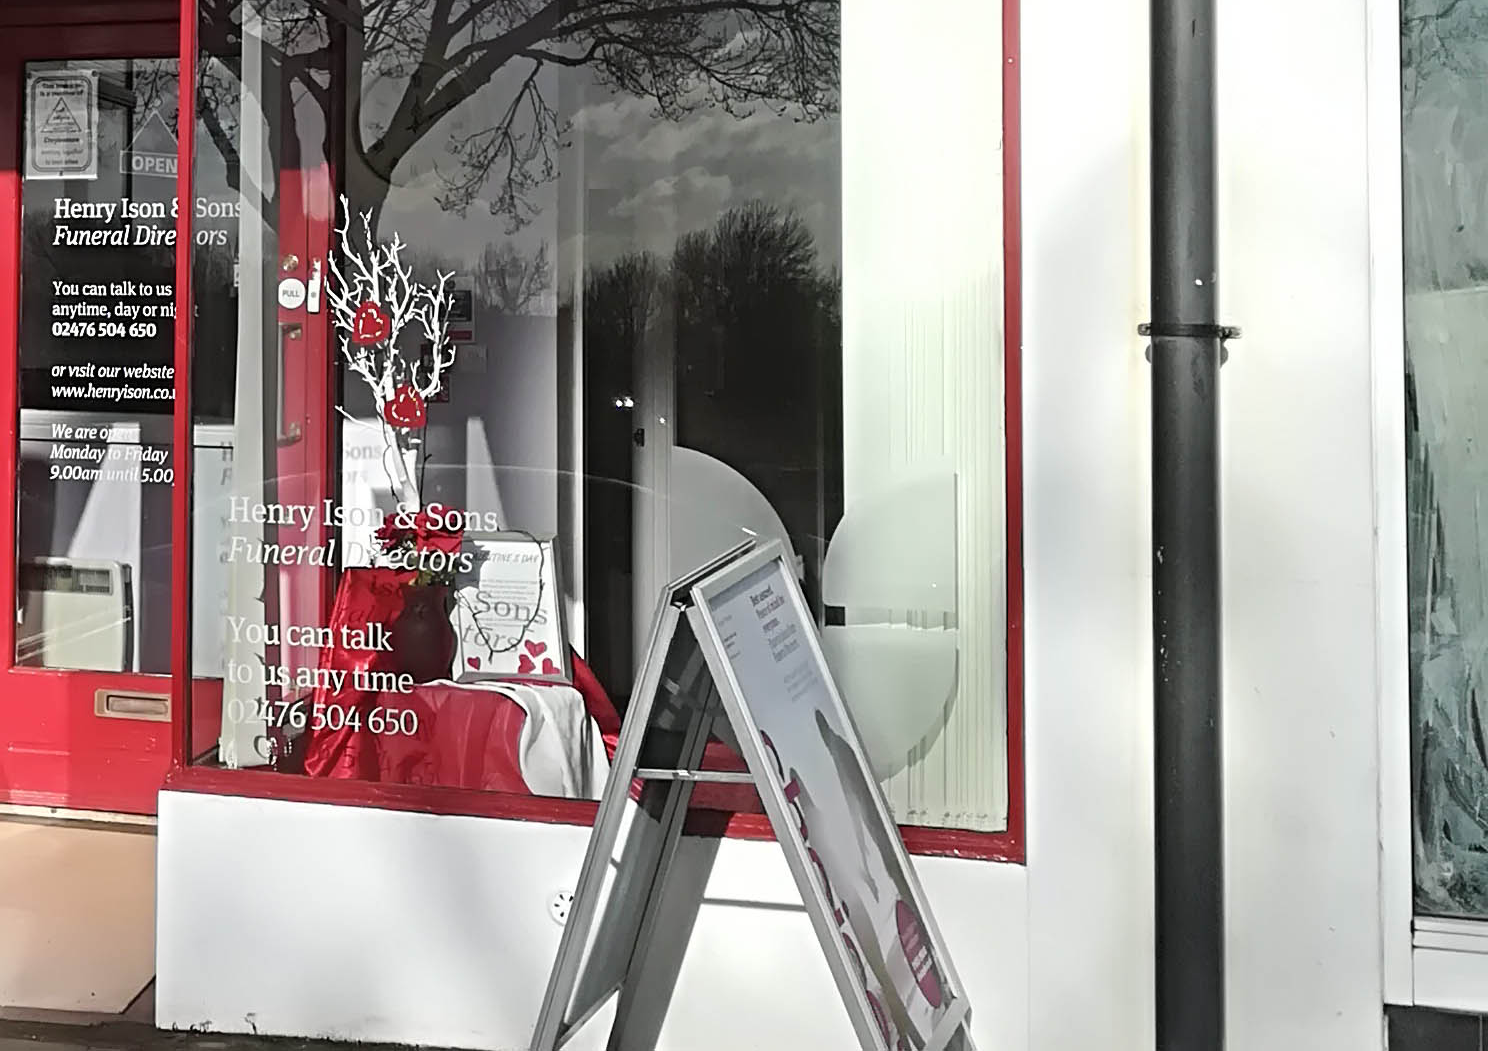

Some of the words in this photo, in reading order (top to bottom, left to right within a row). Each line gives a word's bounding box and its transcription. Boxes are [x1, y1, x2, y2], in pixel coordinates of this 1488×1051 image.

[132, 155, 179, 174] OPEN
[54, 197, 117, 224] Henry
[120, 197, 166, 219] Ison
[52, 224, 130, 247] Funeral
[133, 224, 229, 247] Direors
[52, 280, 79, 297] You
[82, 283, 108, 297] can
[110, 280, 137, 297] talk
[139, 282, 153, 297] to
[156, 285, 173, 297] us
[282, 289, 301, 298] PULL
[51, 301, 112, 320] anytime,
[114, 301, 141, 320] day
[142, 305, 158, 317] or
[51, 321, 97, 337] 02476
[97, 322, 126, 338] 504
[128, 322, 158, 338] 650
[51, 364, 67, 377] or
[68, 362, 96, 378] visit
[97, 365, 121, 378] our
[123, 363, 176, 379] website
[51, 382, 176, 402] www.henryison.co.
[51, 423, 73, 439] We
[74, 426, 98, 439] are
[49, 443, 106, 464] Monday
[107, 447, 121, 461] to
[124, 445, 169, 465] Friday
[49, 464, 104, 481] 9.00am
[106, 466, 140, 483] until
[140, 468, 176, 487] 5.00
[227, 496, 316, 532] Henry
[322, 498, 386, 529] Ison
[394, 501, 420, 531] &
[425, 502, 499, 534] Sons
[227, 536, 335, 568] Funeral
[228, 616, 280, 647] You
[286, 624, 335, 649] can
[341, 623, 394, 652] talk
[228, 659, 252, 685] to
[261, 663, 291, 687] us
[296, 666, 346, 697] any
[352, 664, 415, 695] time
[228, 700, 307, 729] 02476
[311, 704, 362, 733] 504
[367, 708, 419, 736] 650
